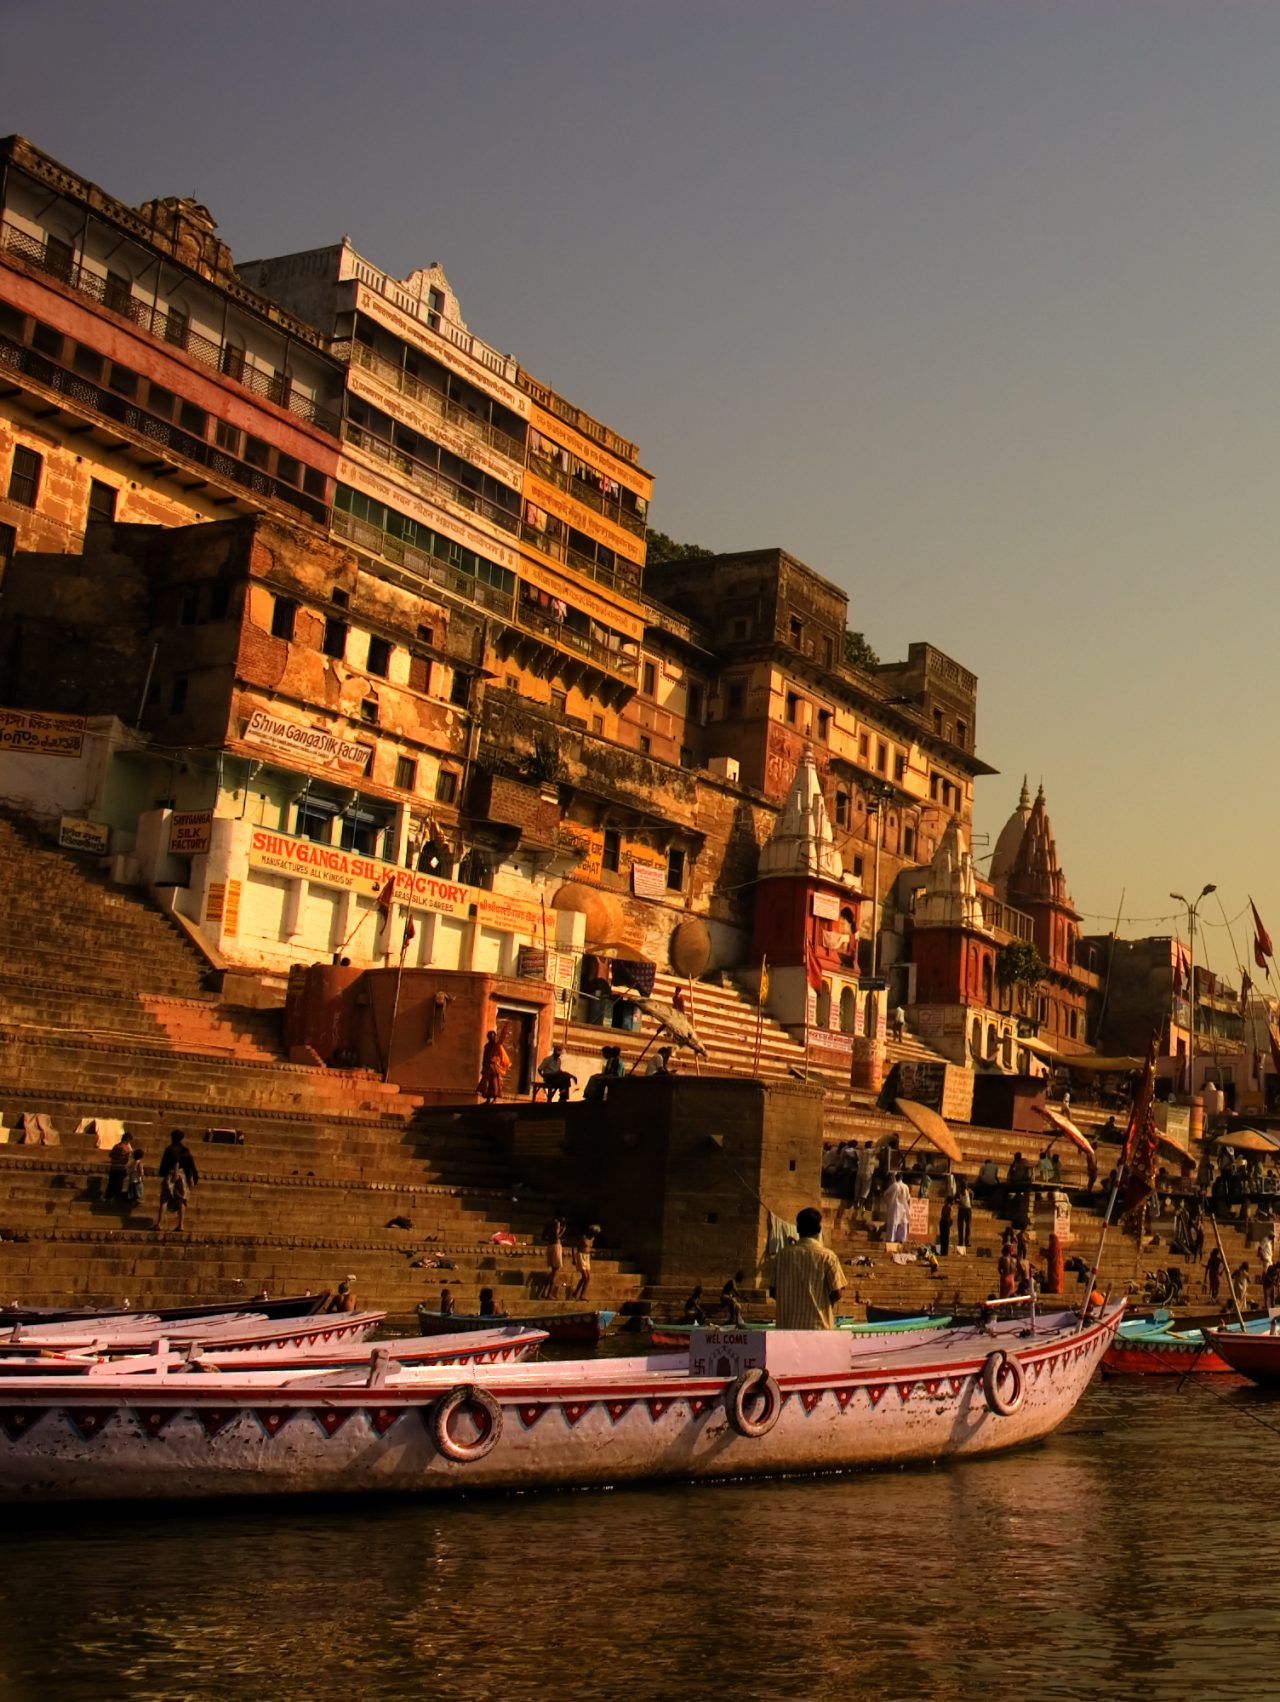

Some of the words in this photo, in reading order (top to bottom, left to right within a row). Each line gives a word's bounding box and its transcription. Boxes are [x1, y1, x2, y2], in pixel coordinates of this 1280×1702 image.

[177, 828, 201, 839] SILK
[171, 838, 207, 849] FACTORY
[253, 832, 349, 874] SHIVGANGA
[351, 859, 394, 883] SILK
[395, 870, 468, 904] FACTORY
